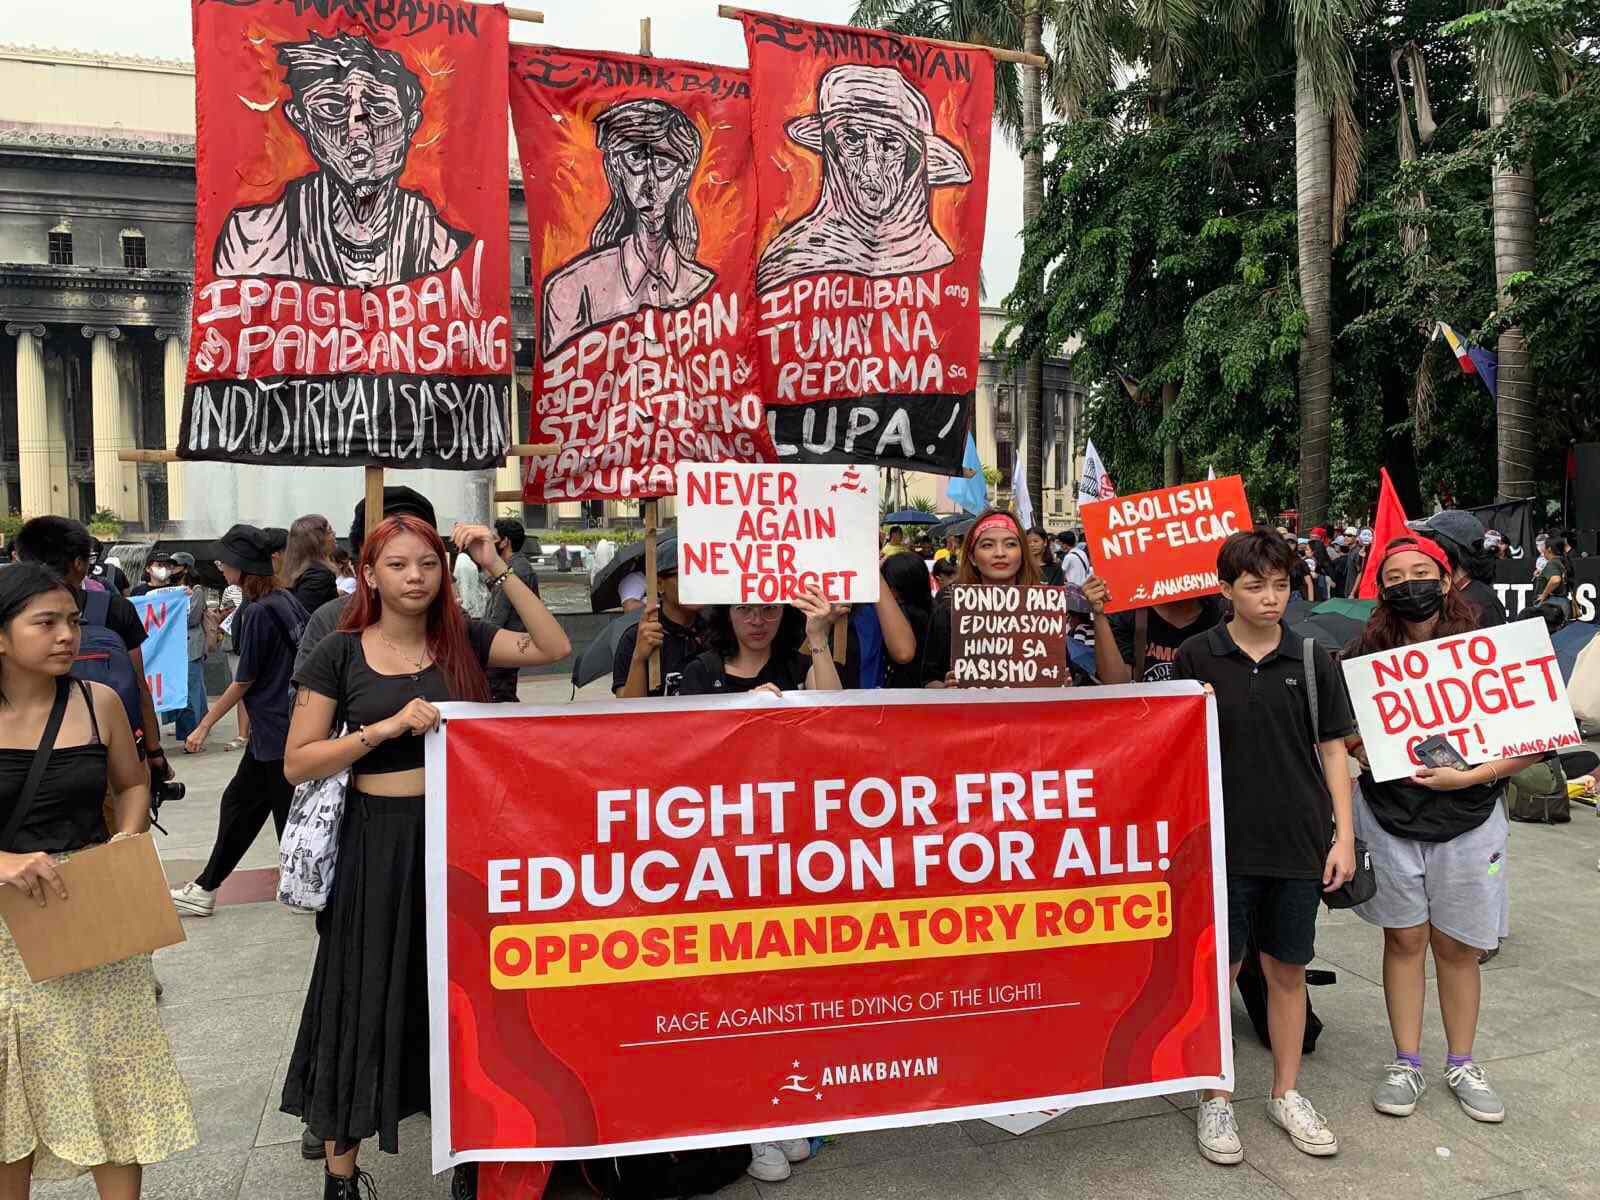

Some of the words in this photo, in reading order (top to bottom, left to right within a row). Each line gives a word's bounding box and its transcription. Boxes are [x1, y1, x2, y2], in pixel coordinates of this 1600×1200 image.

[197, 240, 483, 329] IPAGLABAN
[760, 270, 941, 320] IPAGLABAN
[944, 284, 969, 307] ang
[194, 326, 231, 373] ang
[237, 316, 508, 380] PAMBANSANG
[757, 312, 874, 365] TUNAY
[881, 308, 939, 352] NA
[777, 353, 944, 401] REPORMA
[947, 364, 967, 379] sa
[188, 377, 511, 462] INDUSTRIYALISASYON
[544, 463, 680, 499] EDUKA
[687, 471, 798, 506] NEVER
[736, 506, 836, 541] AGAIN
[1108, 487, 1214, 530] ABOLISH
[683, 542, 798, 575] NEVER
[1101, 510, 1239, 560] NTF-ELCAC
[954, 586, 1020, 611] PONDO
[1026, 588, 1066, 613] PARA
[1152, 570, 1220, 600] ANAKBAYAN
[954, 658, 1038, 682] PASISMO
[1041, 665, 1059, 679] at
[964, 637, 1014, 656] HINDI
[1022, 639, 1047, 658] SA
[1371, 650, 1429, 687] NO
[1437, 636, 1497, 670] TO
[1373, 655, 1558, 735] BUDGET
[1407, 723, 1488, 766] CT!
[596, 781, 796, 843] FIGHT
[813, 775, 938, 831] FOR
[955, 769, 1097, 823] FREE
[487, 836, 895, 914] EDUCATION
[912, 831, 1035, 887] FOR
[1052, 820, 1171, 879] ALL!
[494, 926, 698, 976] OPPOSE
[709, 903, 1026, 962] MANDATORY
[1035, 890, 1169, 938] ROTC!
[656, 1012, 710, 1034] RAGE
[717, 1003, 805, 1029] AGAINST
[811, 1000, 844, 1020] THE
[851, 994, 913, 1017] DYING
[919, 991, 945, 1010] OF
[949, 988, 982, 1007] THE
[988, 982, 1042, 1004] LIGHT!
[821, 1056, 939, 1086] ANAKBAYAN
